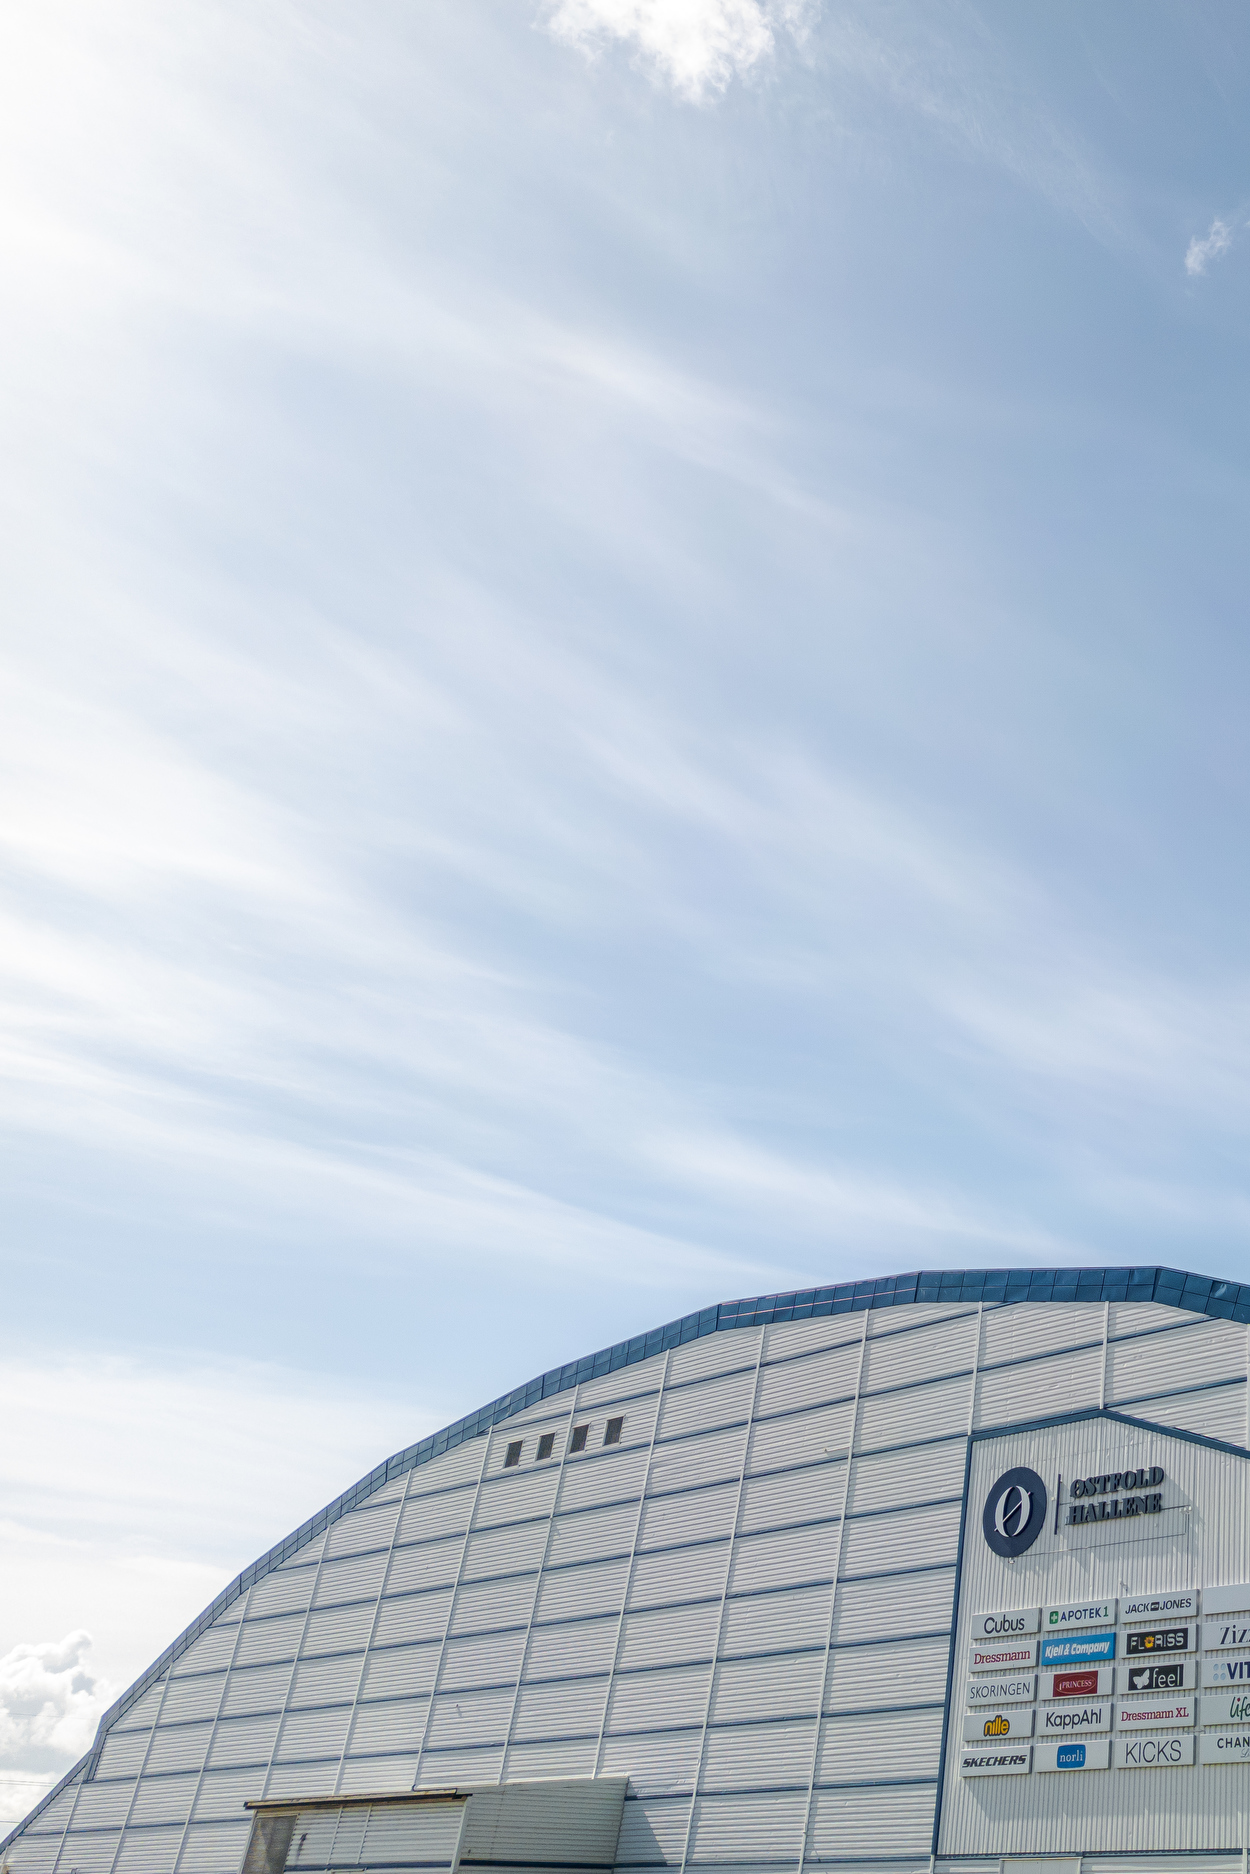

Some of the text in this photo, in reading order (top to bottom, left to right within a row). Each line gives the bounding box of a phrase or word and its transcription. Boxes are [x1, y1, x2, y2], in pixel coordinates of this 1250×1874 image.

[1070, 1466, 1164, 1498] ØSTFOLD
[1066, 1493, 1162, 1526] HALLENE
[1060, 1606, 1109, 1622] APOTEK 1
[1125, 1602, 1149, 1614] JACK
[1160, 1598, 1191, 1610] JONES
[984, 1614, 1025, 1634] Cubus
[974, 1650, 1031, 1664] Dressmann
[1045, 1640, 1110, 1658] Kjell & Company
[1152, 1668, 1180, 1687] feel
[970, 1682, 1030, 1699] SKORINGEN
[1045, 1708, 1102, 1730] KappAhl
[1121, 1707, 1189, 1722] Dressmann XL
[984, 1716, 1009, 1736] nille
[962, 1754, 1027, 1768] SKECHERS
[1060, 1750, 1083, 1762] norli
[1125, 1740, 1182, 1764] KICKS
